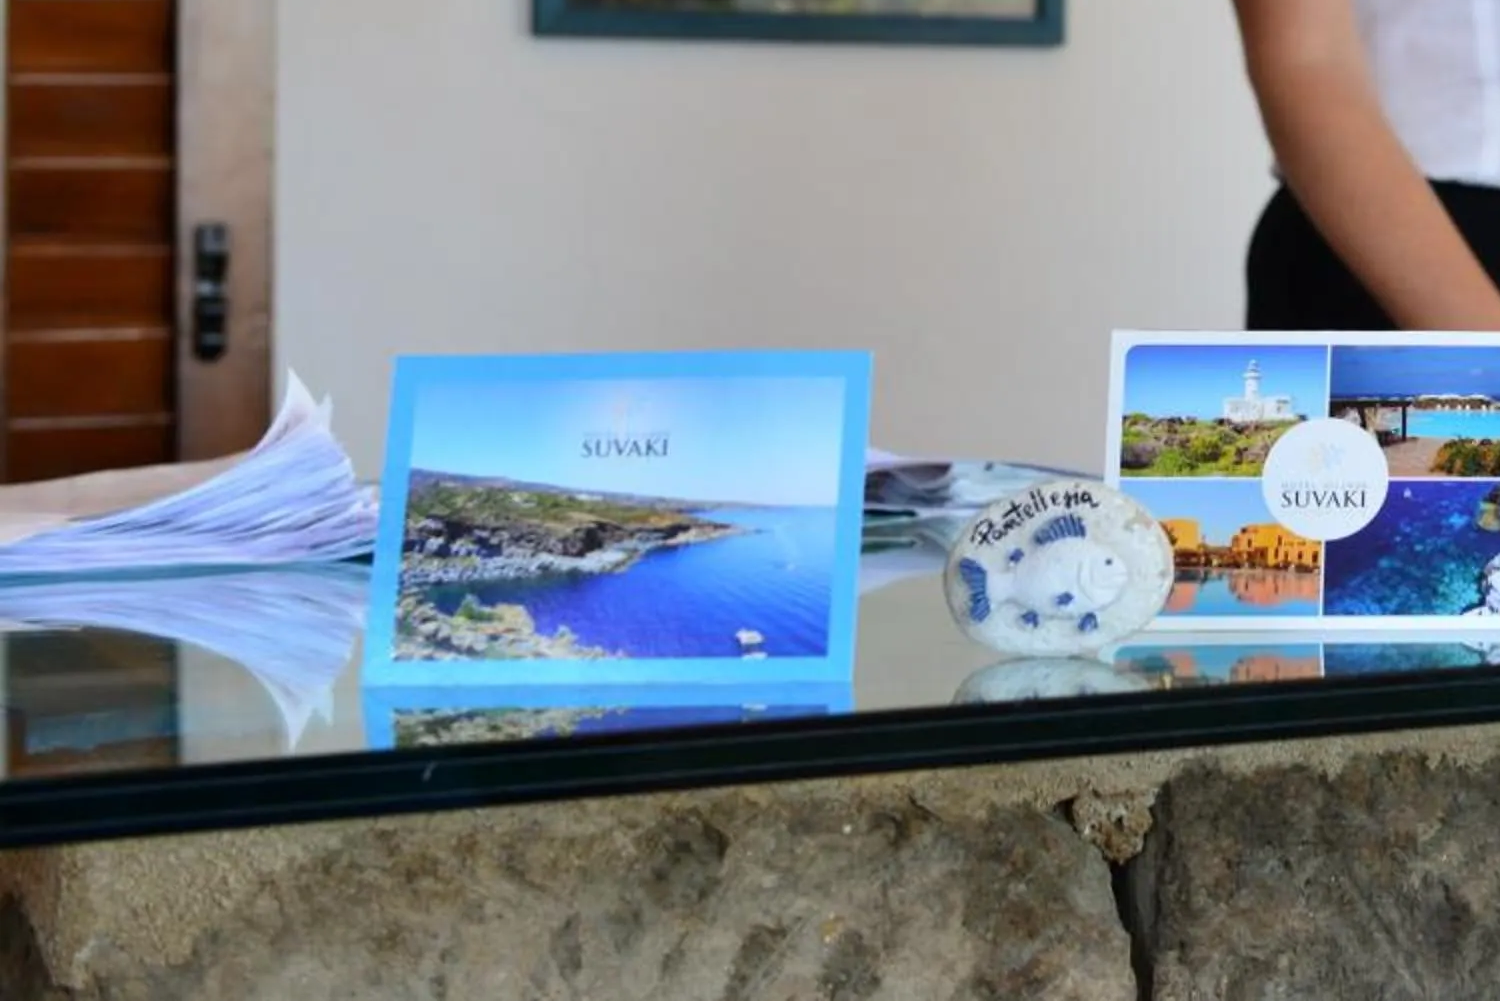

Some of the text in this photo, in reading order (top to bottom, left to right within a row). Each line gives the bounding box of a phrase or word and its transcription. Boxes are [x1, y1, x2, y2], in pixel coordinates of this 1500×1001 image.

[580, 438, 669, 458] SUVAKI
[1281, 490, 1366, 508] SUVAKI
[970, 483, 1099, 546] Pantelleria
